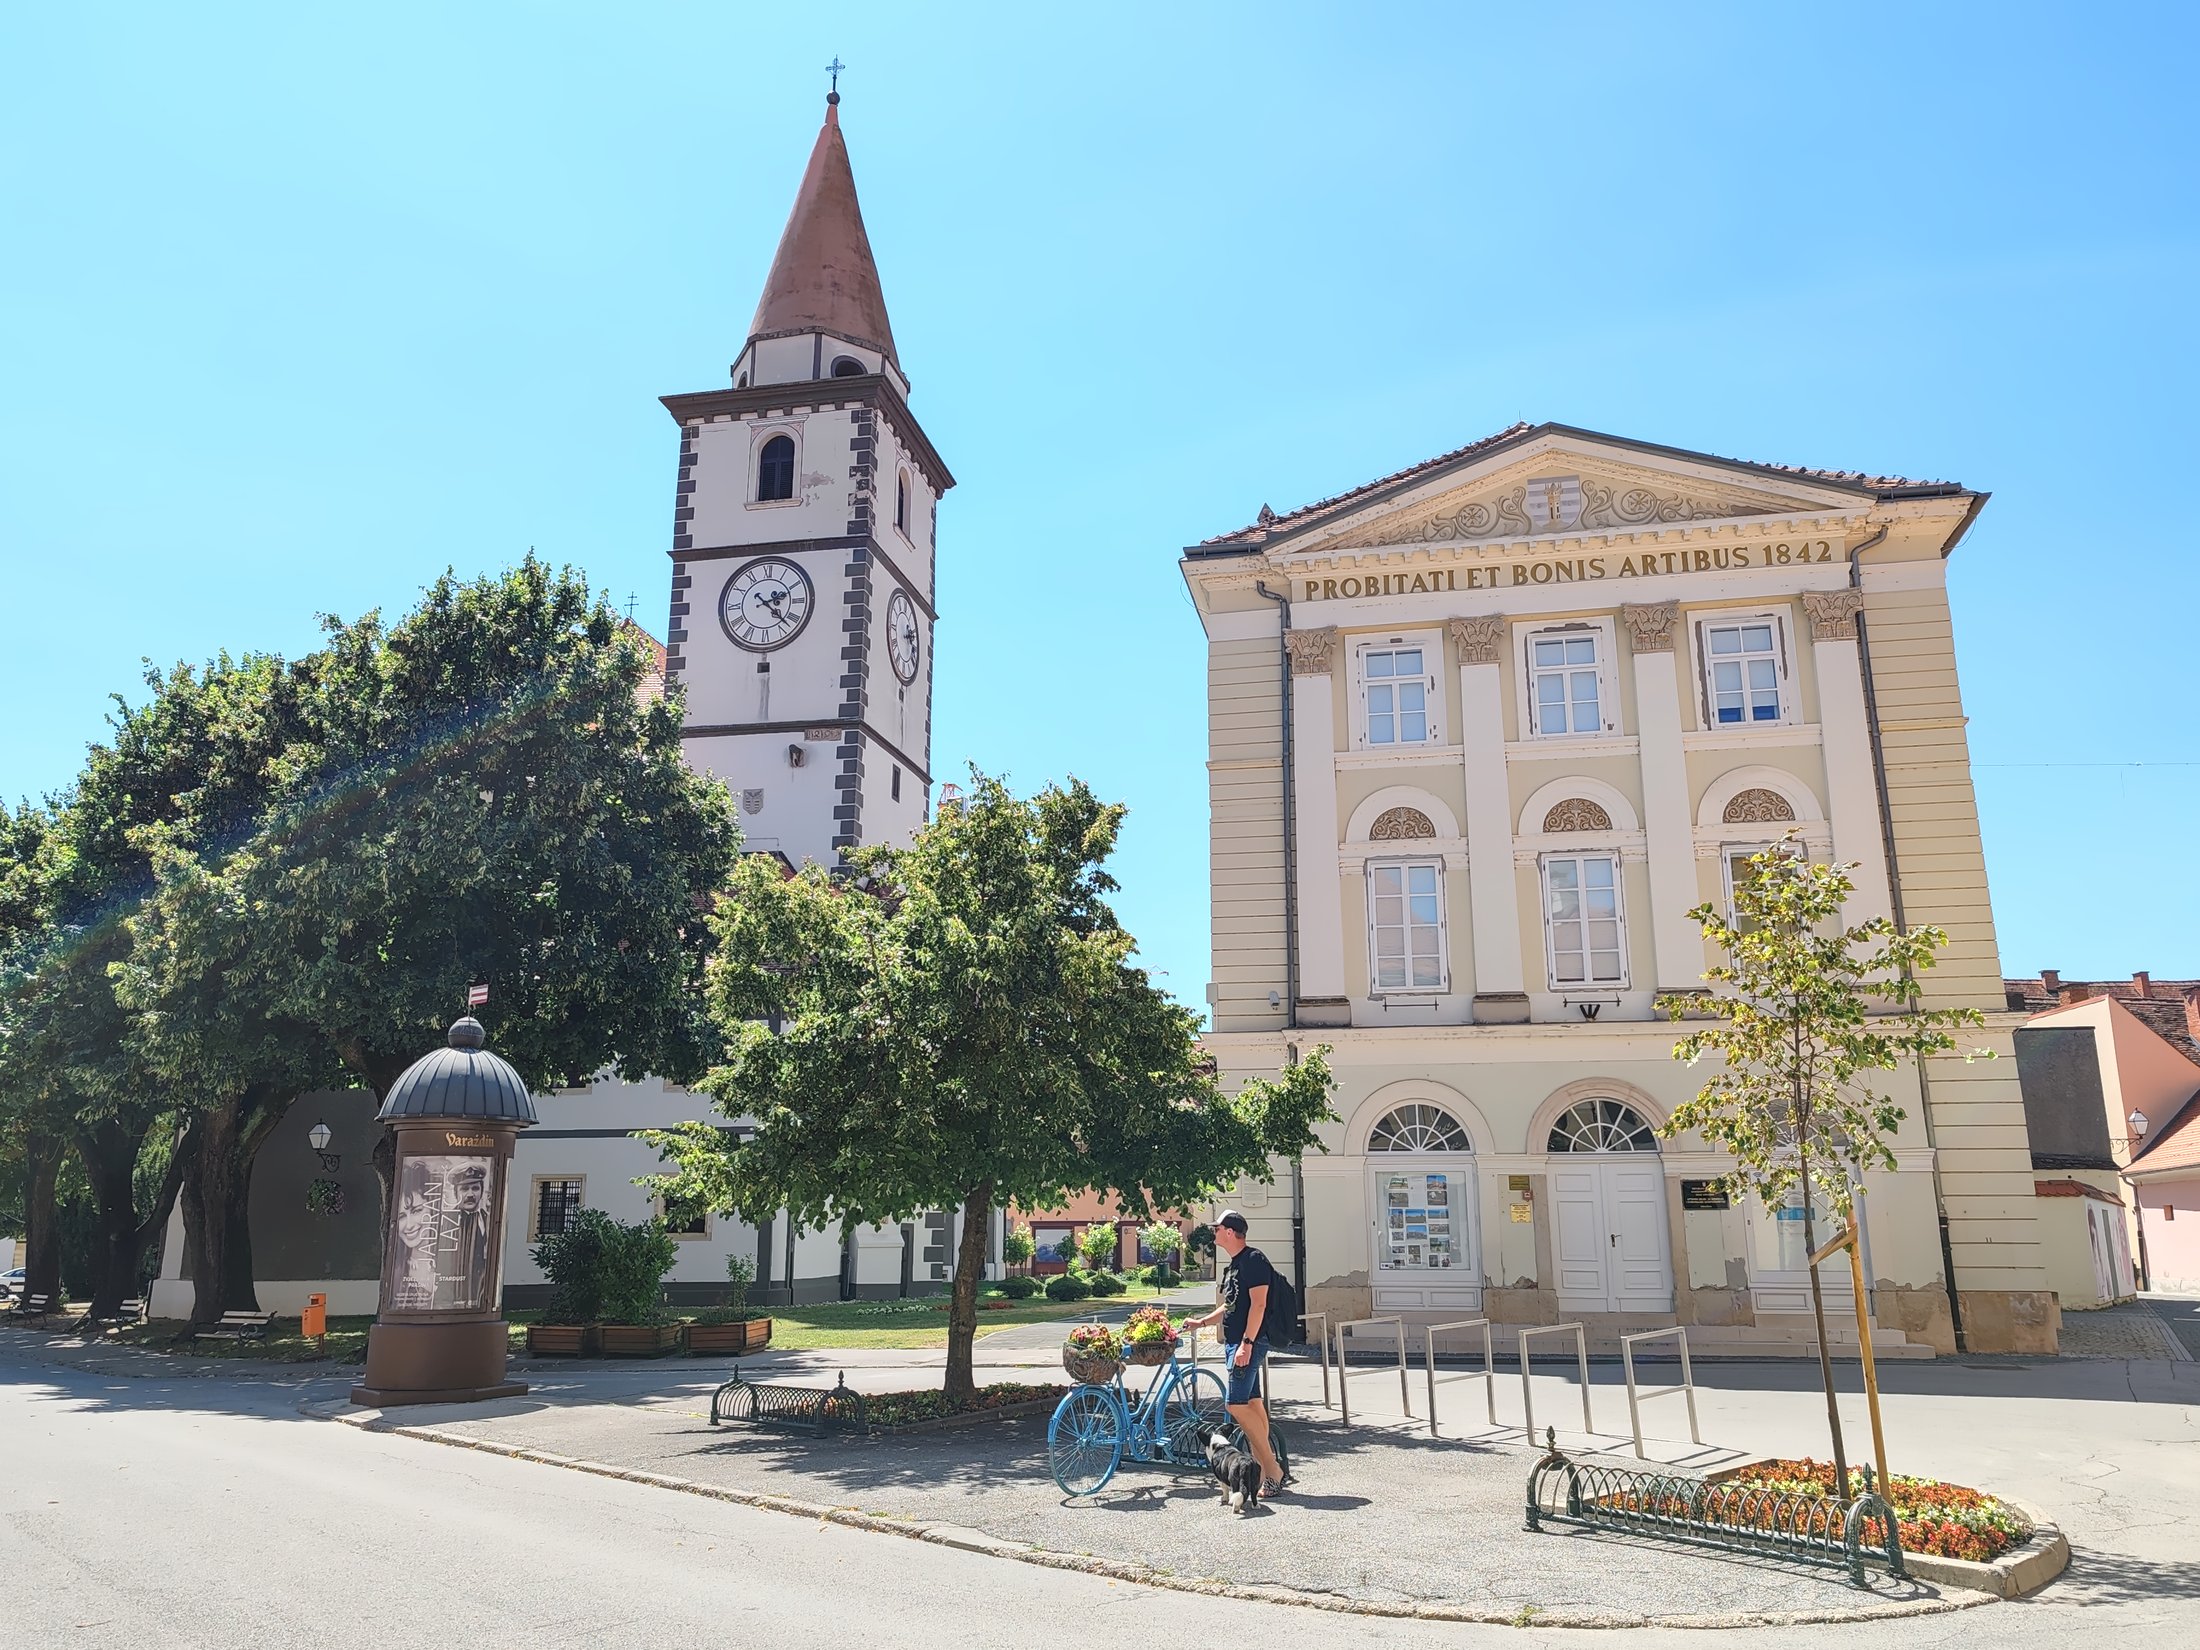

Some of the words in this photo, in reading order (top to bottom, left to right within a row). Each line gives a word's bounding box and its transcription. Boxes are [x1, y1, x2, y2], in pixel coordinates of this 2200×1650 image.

[1305, 569, 1455, 601] PROBITATI
[1466, 566, 1500, 589] ET
[1512, 558, 1606, 586] BONIS
[1618, 546, 1750, 577] ARTIBUS
[1762, 540, 1832, 566] 1842
[418, 1182, 443, 1266] JADRAN
